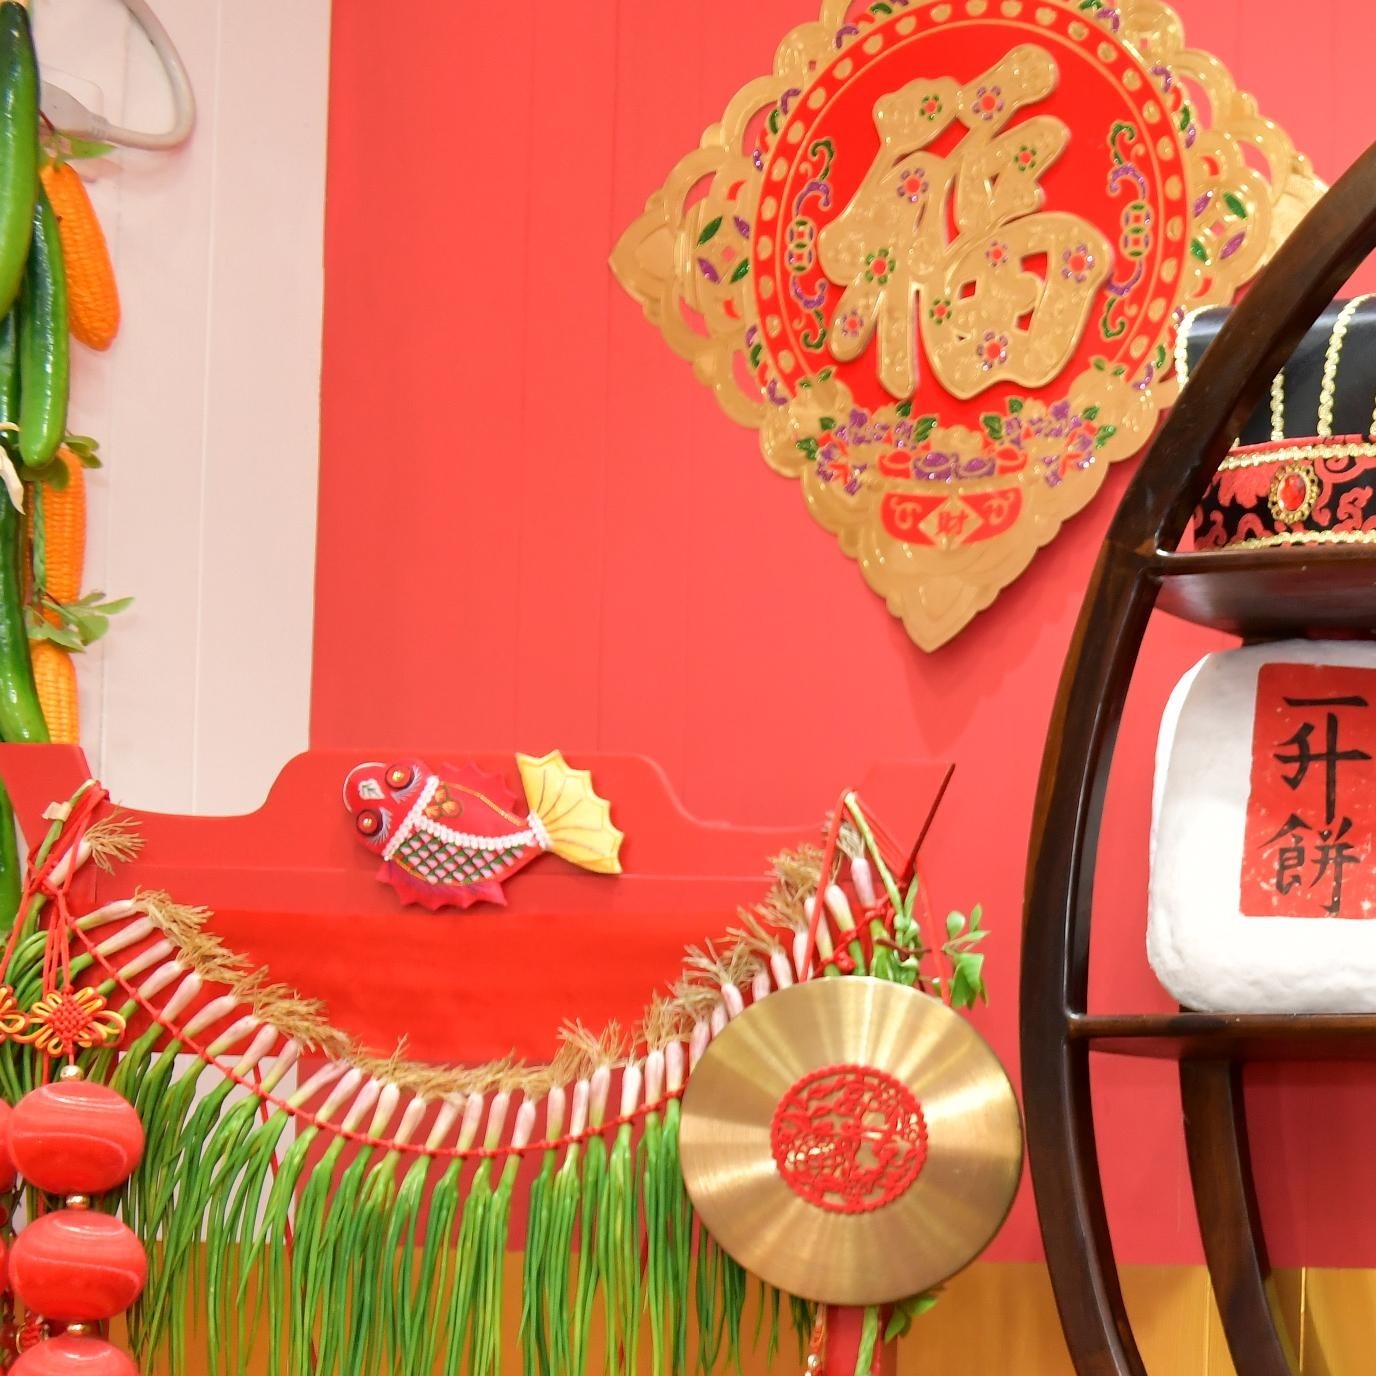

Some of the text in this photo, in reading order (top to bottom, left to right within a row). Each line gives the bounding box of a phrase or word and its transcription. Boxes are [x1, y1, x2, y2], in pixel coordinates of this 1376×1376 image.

[818, 43, 1113, 400] 福
[934, 509, 969, 537] 財
[1258, 695, 1373, 914] 一升餅
